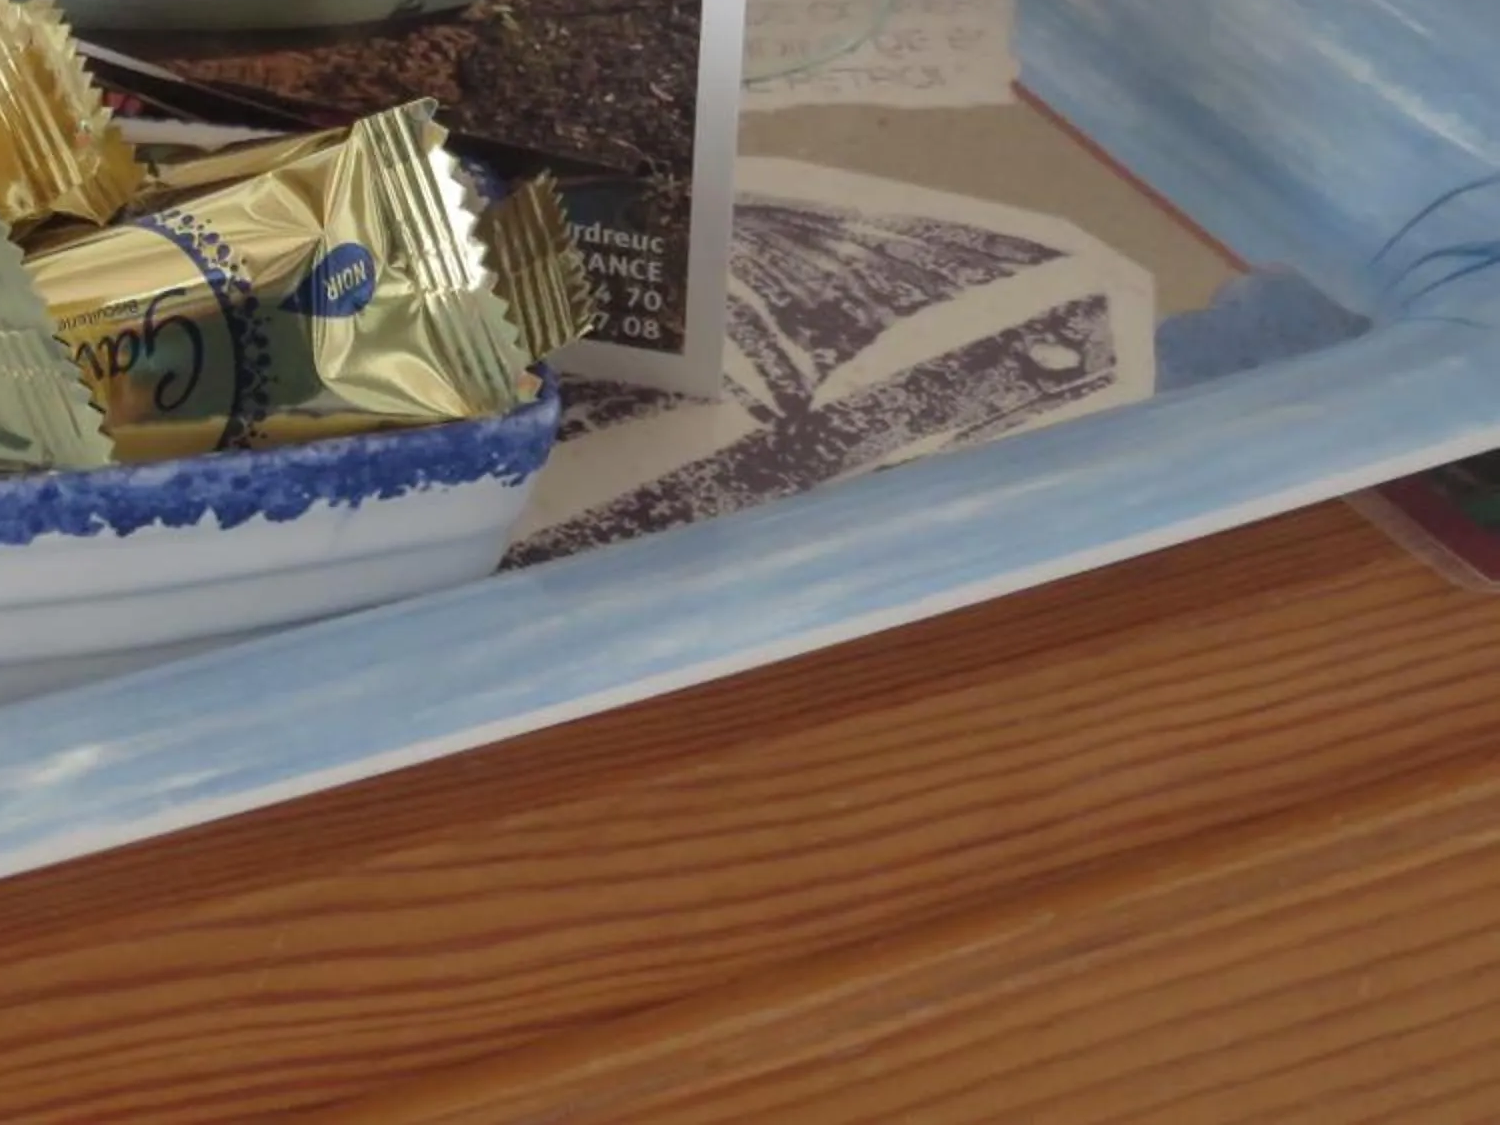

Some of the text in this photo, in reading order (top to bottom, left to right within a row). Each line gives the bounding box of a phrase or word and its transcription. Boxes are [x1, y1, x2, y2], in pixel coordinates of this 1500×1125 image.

[322, 258, 368, 302] NOIR
[584, 251, 663, 284] ANCE
[626, 286, 663, 312] 70
